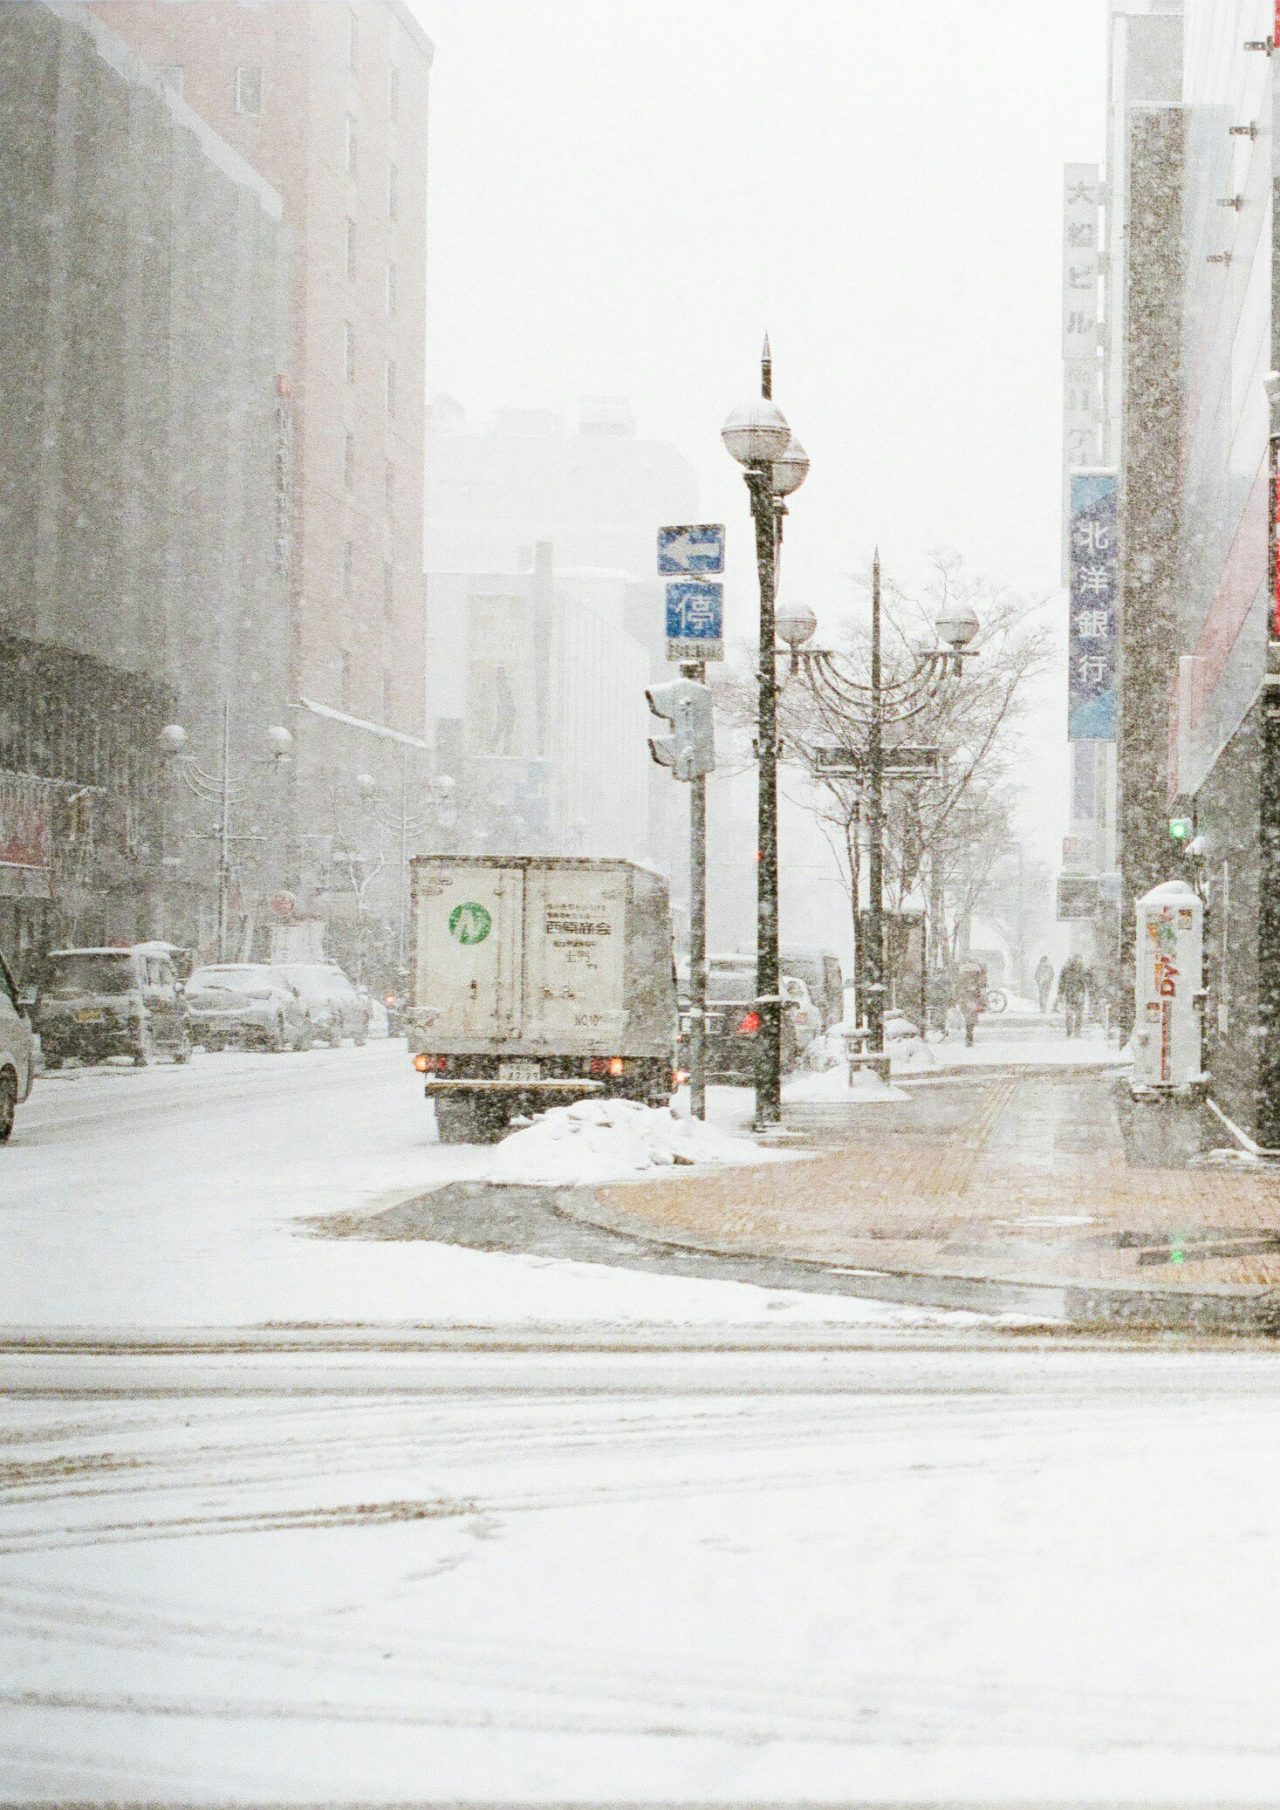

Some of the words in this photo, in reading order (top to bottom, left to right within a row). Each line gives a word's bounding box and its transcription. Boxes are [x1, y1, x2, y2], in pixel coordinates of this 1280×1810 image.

[675, 593, 715, 630] 停
[1076, 519, 1109, 683] 北洋銀行
